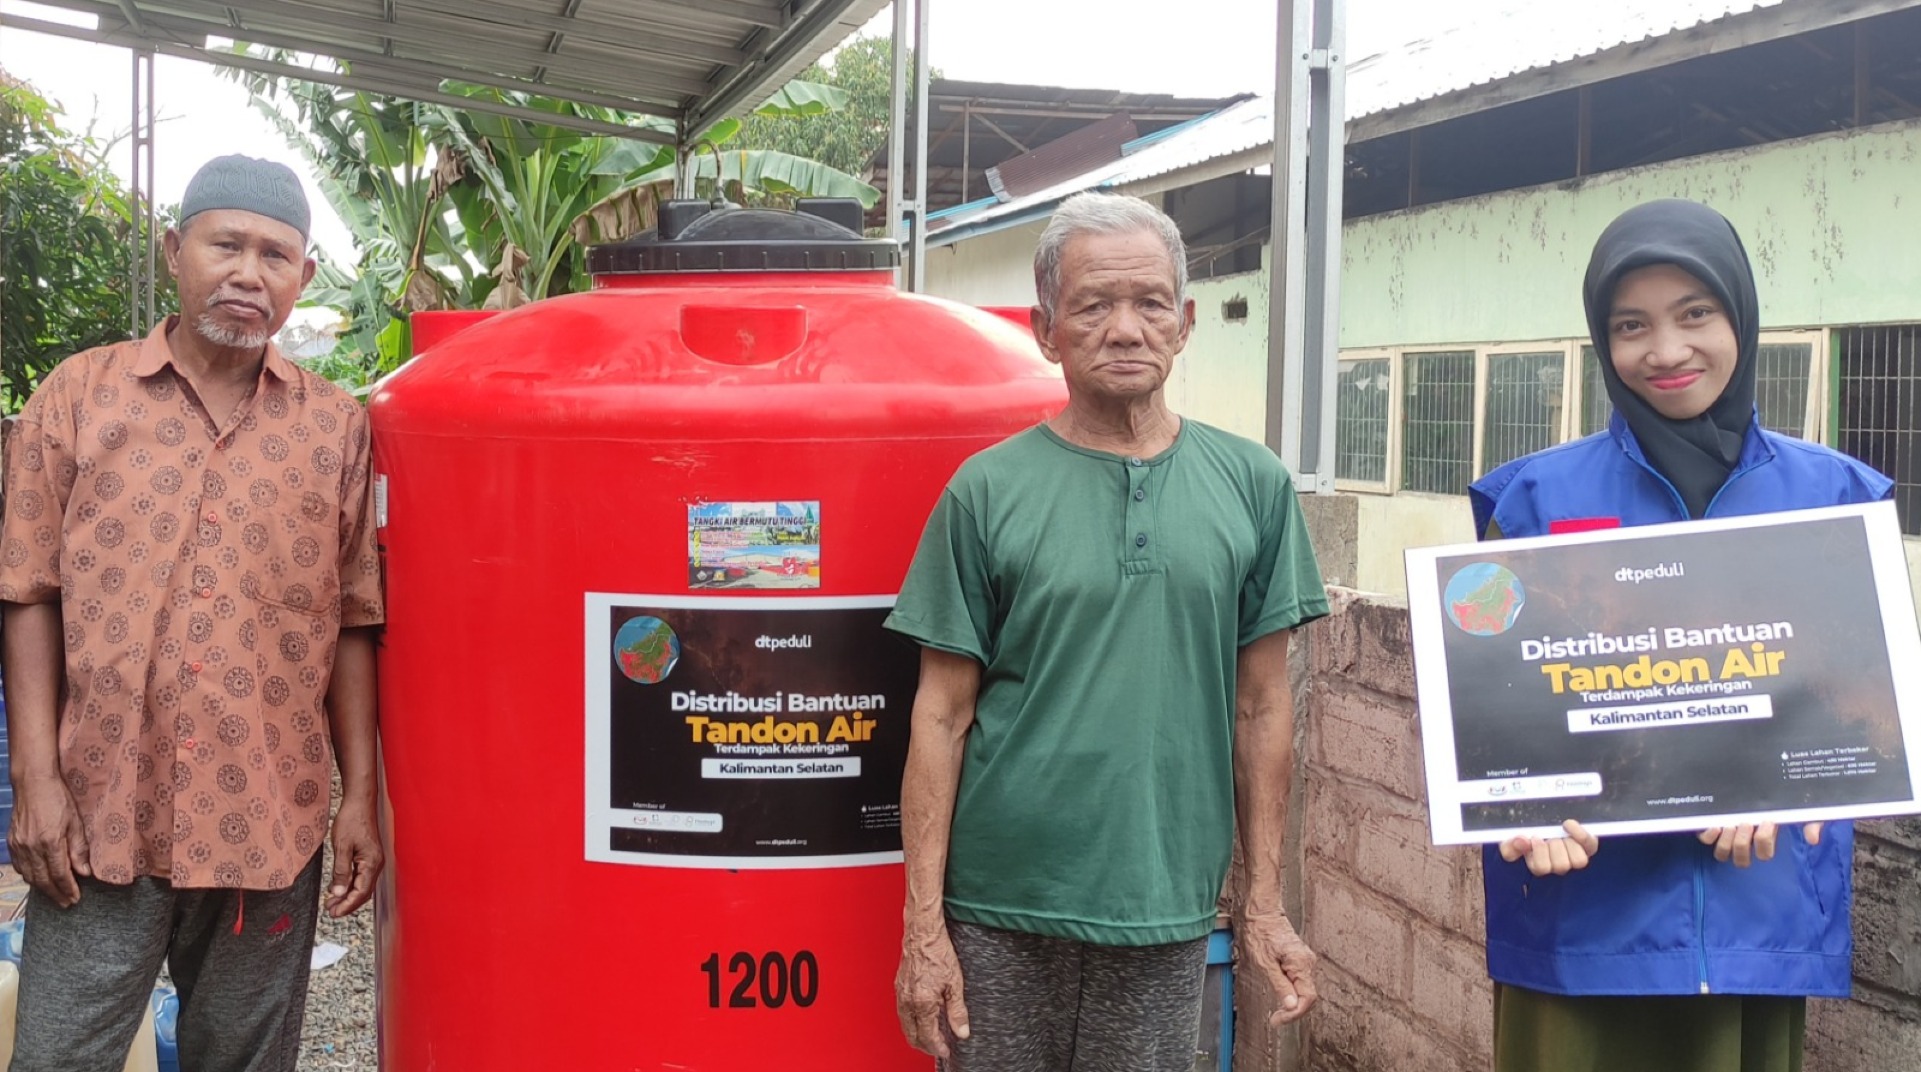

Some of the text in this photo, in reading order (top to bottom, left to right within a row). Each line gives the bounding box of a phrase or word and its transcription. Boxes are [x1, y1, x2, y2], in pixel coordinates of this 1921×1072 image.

[694, 516, 723, 526] TANGKI
[724, 516, 738, 526] AIR
[739, 516, 778, 526] BERMUTU
[1614, 561, 1685, 585] dtpeduli
[754, 634, 812, 653] dtpeduli
[1520, 621, 1794, 661] Distribusi Bantuan
[1541, 641, 1786, 694] Tandon Air
[671, 690, 886, 713] Distribusi Bantuan
[1580, 678, 1753, 703] Terdampak Kekeringan
[1590, 702, 1749, 726] Kalimantan Selatan
[685, 711, 877, 744] Tandon Air
[714, 742, 849, 756] Terdampak Kekeringan
[719, 761, 844, 775] Kalimantan Selatan
[1486, 767, 1528, 777] Member of
[700, 950, 819, 1009] 1200
